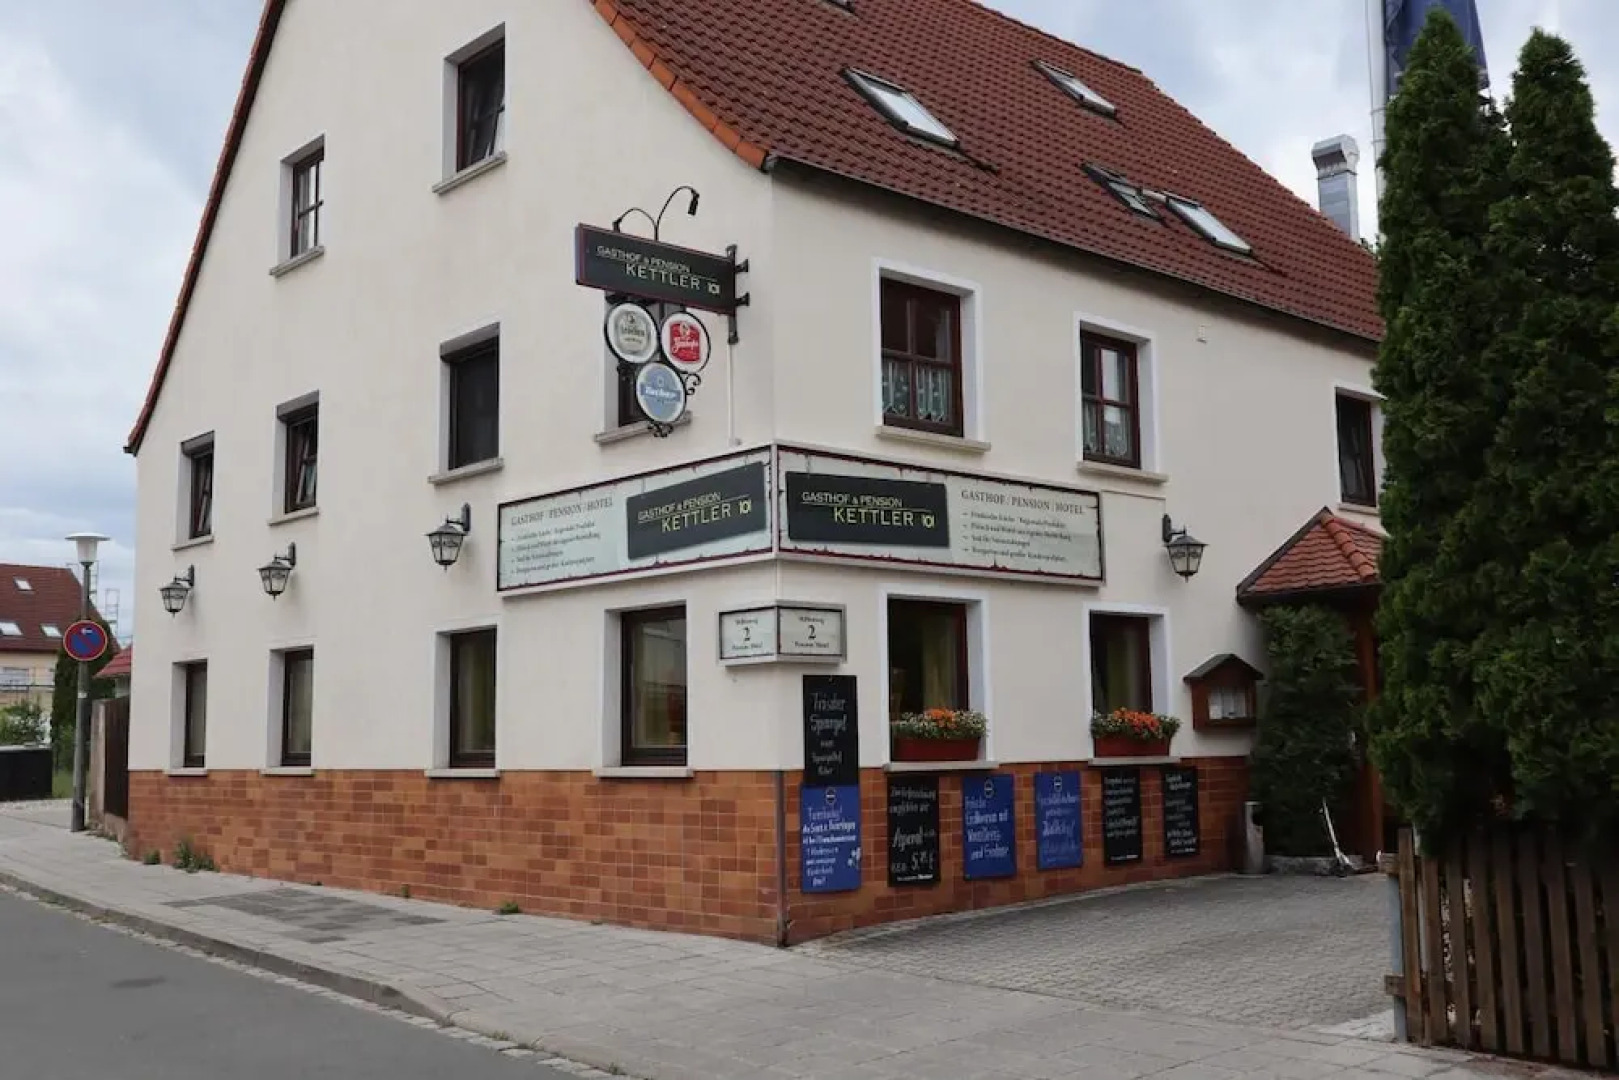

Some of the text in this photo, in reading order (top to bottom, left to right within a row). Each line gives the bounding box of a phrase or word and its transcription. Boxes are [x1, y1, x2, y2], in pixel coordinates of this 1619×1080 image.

[596, 245, 641, 264] GASTHOF
[650, 257, 691, 273] PENSION
[625, 263, 701, 291] KETTLER
[511, 511, 545, 526] GASTHOF
[549, 503, 582, 519] PENSION
[587, 497, 613, 511] HOTEL
[638, 502, 676, 521] GASTHOF
[684, 491, 721, 509] PENSION
[802, 491, 851, 503] GASTHOF
[860, 494, 903, 508] PENSION
[961, 489, 1006, 506] GASTHOF
[1012, 496, 1050, 511] PENSION
[1056, 501, 1084, 514] HOTEL
[662, 503, 731, 533] KETTLER
[834, 507, 914, 527] KETTLER
[744, 626, 751, 642] 2
[808, 624, 817, 640] 2
